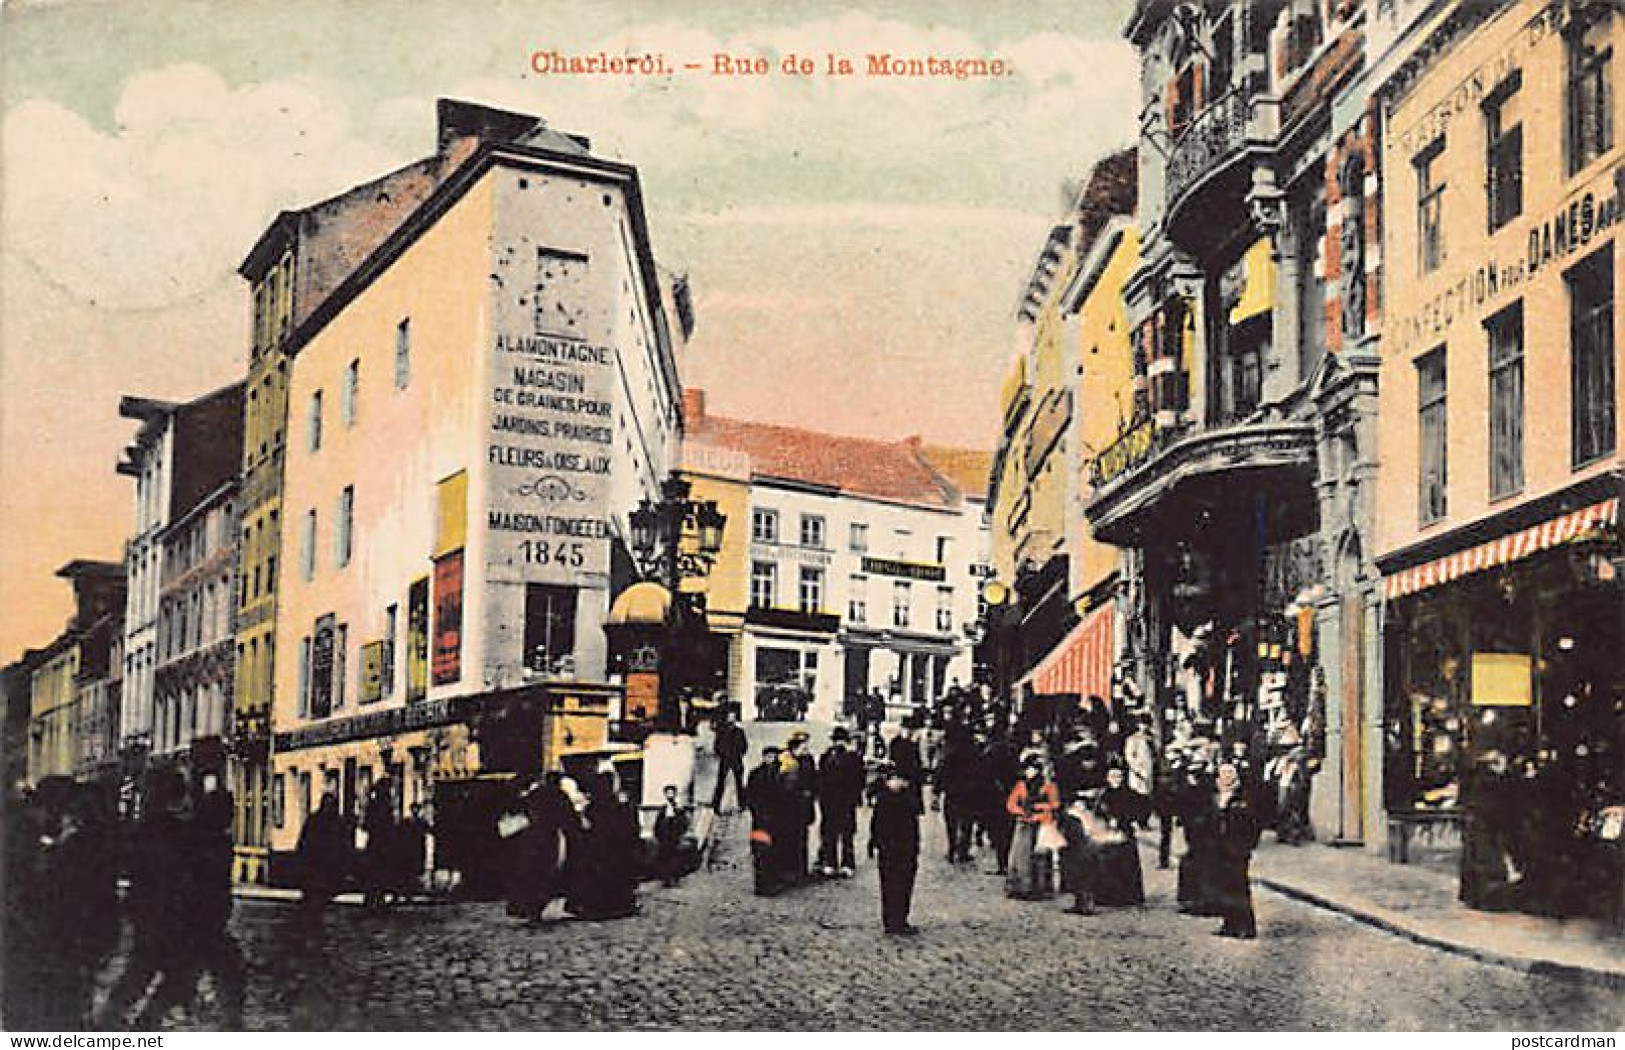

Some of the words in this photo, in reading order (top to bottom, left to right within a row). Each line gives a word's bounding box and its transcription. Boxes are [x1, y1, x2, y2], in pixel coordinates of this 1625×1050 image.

[1528, 190, 1595, 274] DAMES
[514, 366, 585, 393] MAGASIN
[494, 387, 514, 405] DE
[554, 421, 612, 444] PRAIRIES
[490, 445, 544, 468] FLEURS
[554, 453, 612, 475] OISEAUX
[489, 511, 543, 533] MAISON
[518, 539, 584, 567] 1845
